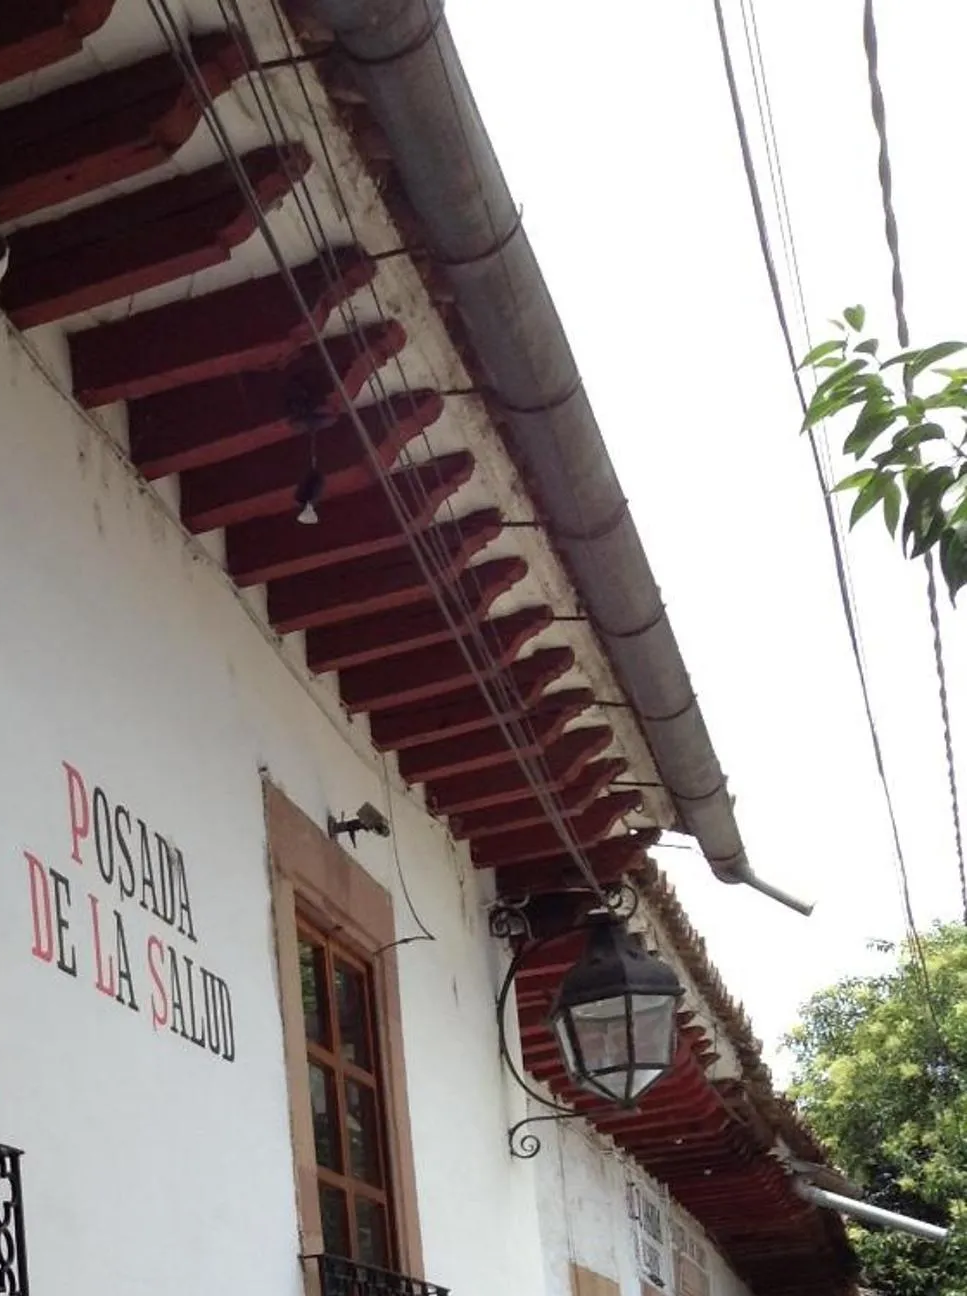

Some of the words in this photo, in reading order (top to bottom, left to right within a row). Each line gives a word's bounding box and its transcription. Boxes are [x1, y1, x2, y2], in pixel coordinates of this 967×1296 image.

[62, 759, 197, 943] POSADA
[23, 851, 77, 978] DE
[88, 893, 139, 1012] LA
[147, 935, 235, 1063] SALUD
